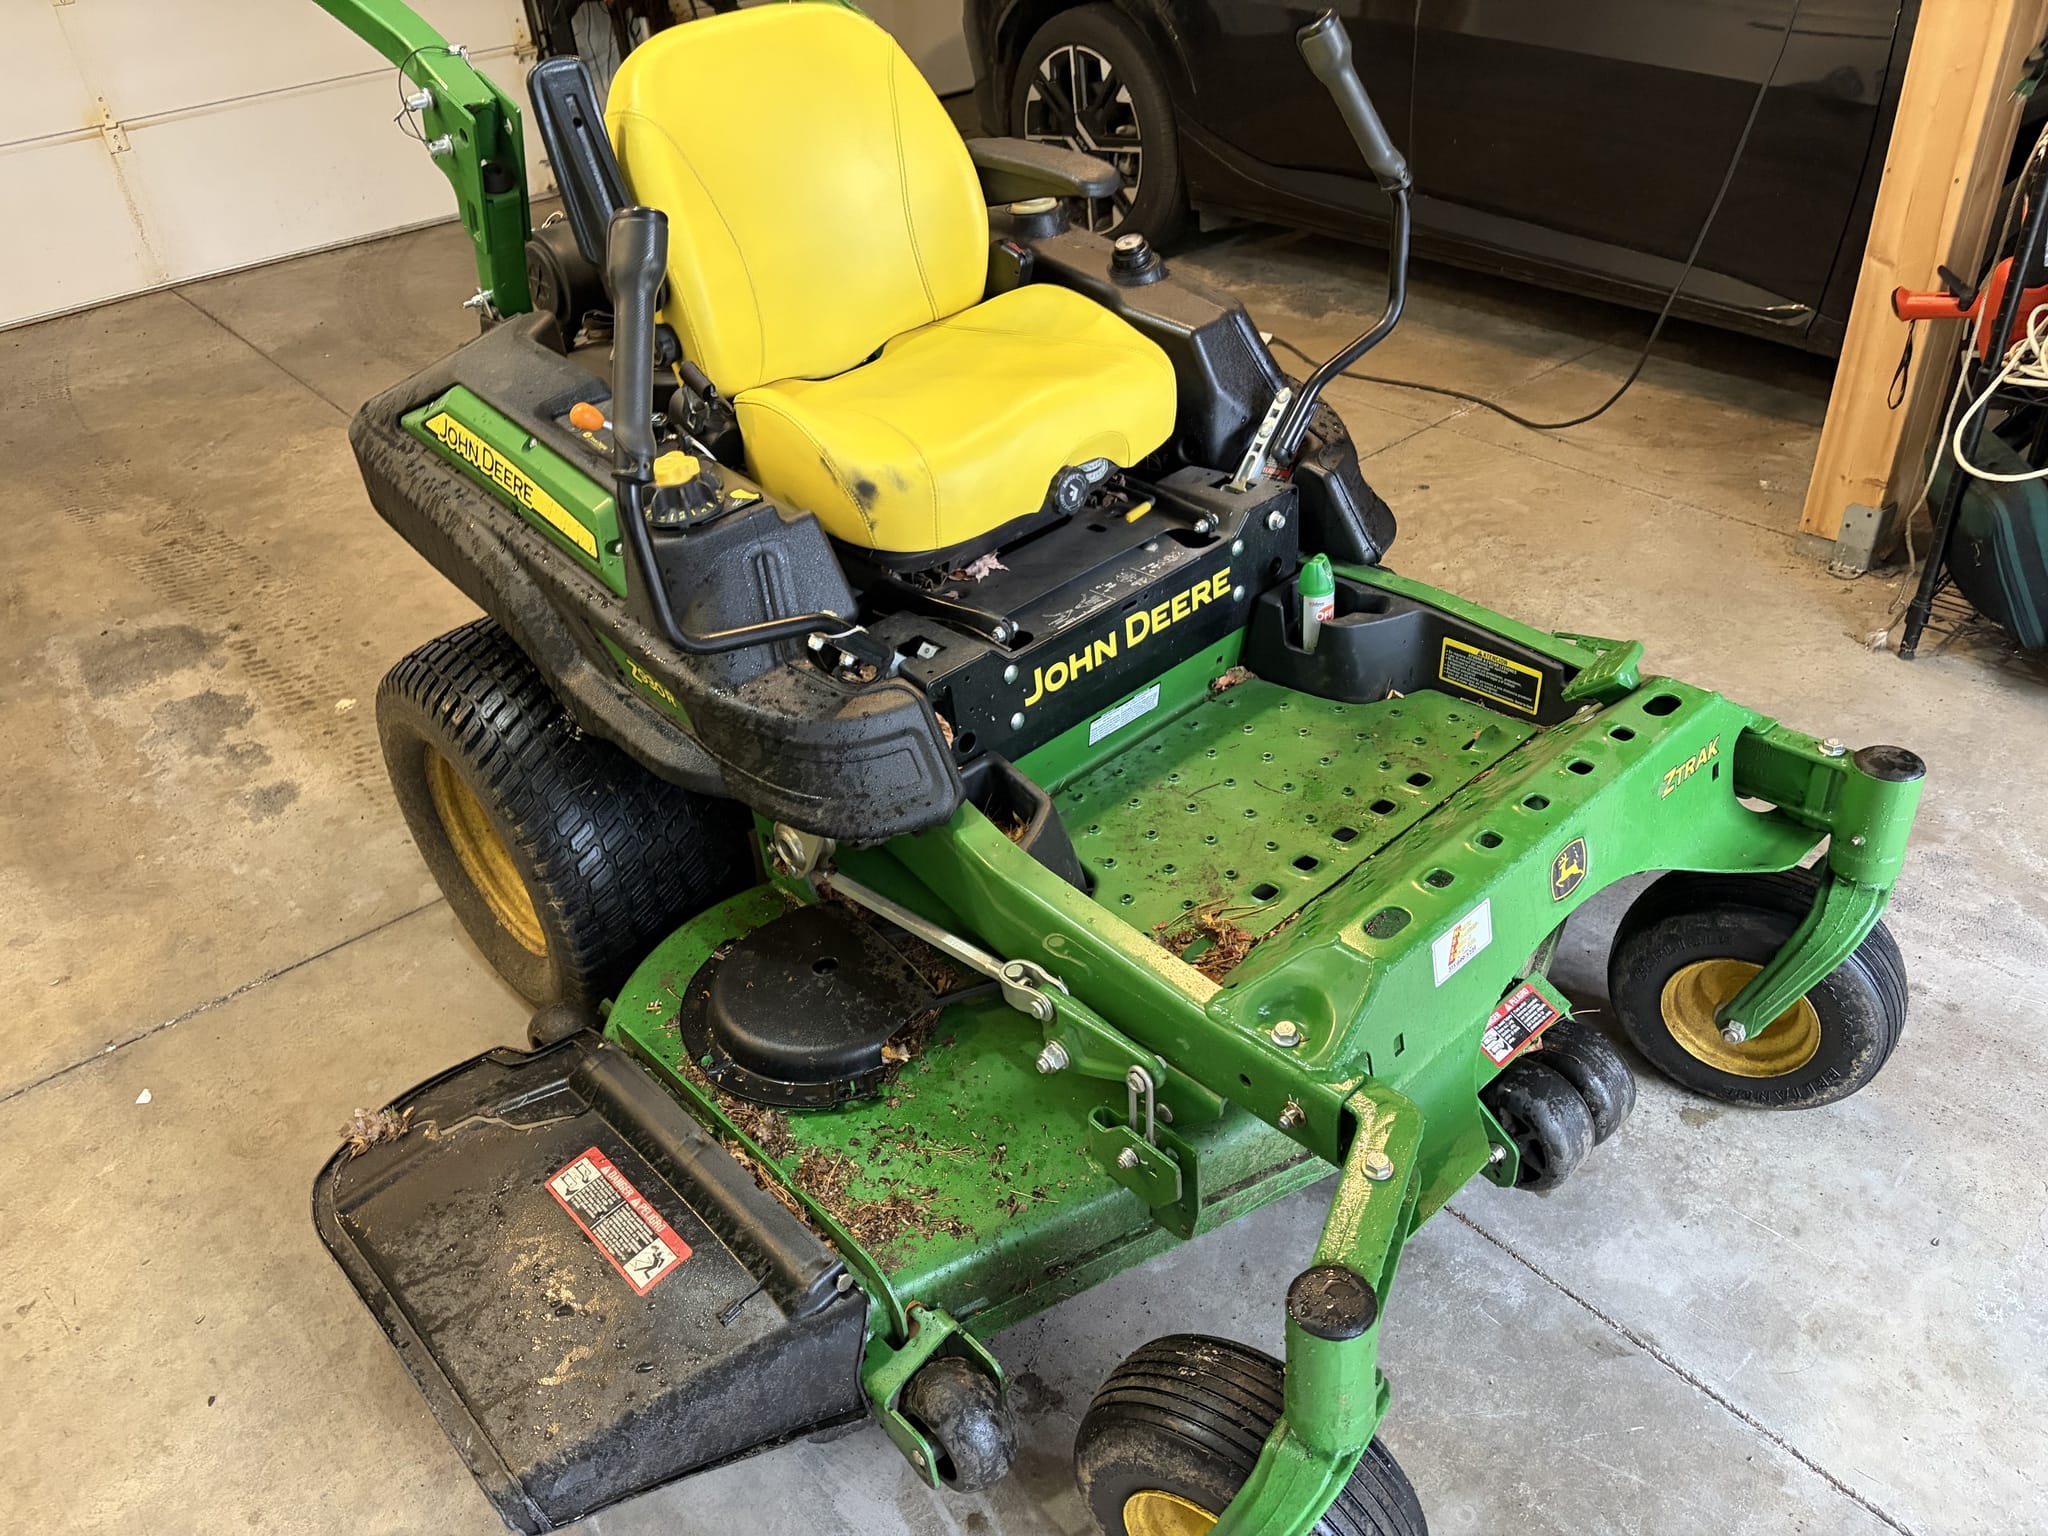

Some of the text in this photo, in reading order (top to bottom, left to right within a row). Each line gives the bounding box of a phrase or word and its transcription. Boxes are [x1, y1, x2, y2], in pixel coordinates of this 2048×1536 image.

[438, 418, 534, 506] JOHN DEERE
[1024, 630, 1118, 707] JOHN
[1124, 566, 1232, 649] DEERE
[607, 1169, 635, 1198] DANGER
[637, 1203, 667, 1233] PELIGRO
